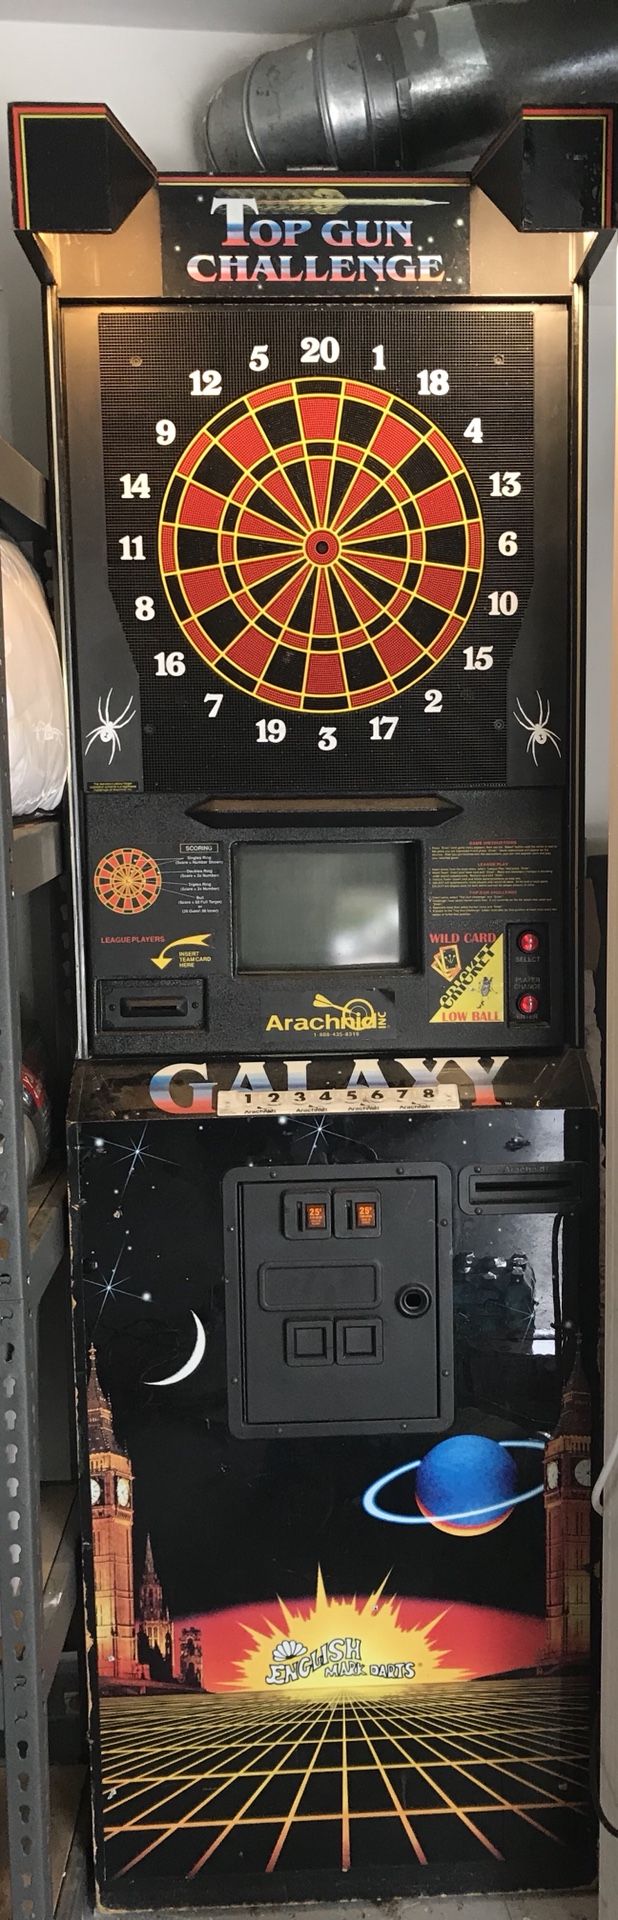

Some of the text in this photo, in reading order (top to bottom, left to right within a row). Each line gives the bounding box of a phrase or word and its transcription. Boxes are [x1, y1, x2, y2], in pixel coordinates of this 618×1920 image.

[210, 197, 413, 247] TOP GUN
[186, 254, 446, 282] CHALLENGE
[249, 345, 269, 371] 5
[301, 337, 339, 363] 20
[372, 345, 386, 370] 1
[189, 370, 222, 395] 12
[417, 369, 449, 395] 18
[156, 419, 176, 445] 9
[464, 418, 483, 443] 4
[120, 474, 150, 498] 14
[489, 472, 521, 497] 13
[119, 536, 146, 560] 11
[499, 531, 517, 556] 6
[135, 596, 155, 620] 8
[488, 591, 518, 615] 10
[154, 652, 185, 676] 16
[463, 646, 493, 670] 15
[204, 694, 223, 717] 7
[424, 690, 442, 712] 2
[256, 719, 286, 743] 19
[318, 727, 337, 750] 3
[369, 716, 399, 739] 17
[132, 935, 165, 943] PLAYERS
[429, 932, 497, 943] WILD CARD
[440, 943, 495, 1009] CRICKET
[265, 1013, 377, 1031] Arachnid
[377, 1011, 387, 1029] INC
[441, 1011, 500, 1021] LOW BALL
[244, 1088, 435, 1104] 1 2 3 4 5 6 7 8
[265, 1637, 362, 1684] ENGLISH
[324, 1661, 415, 1679] MARK DARTS
